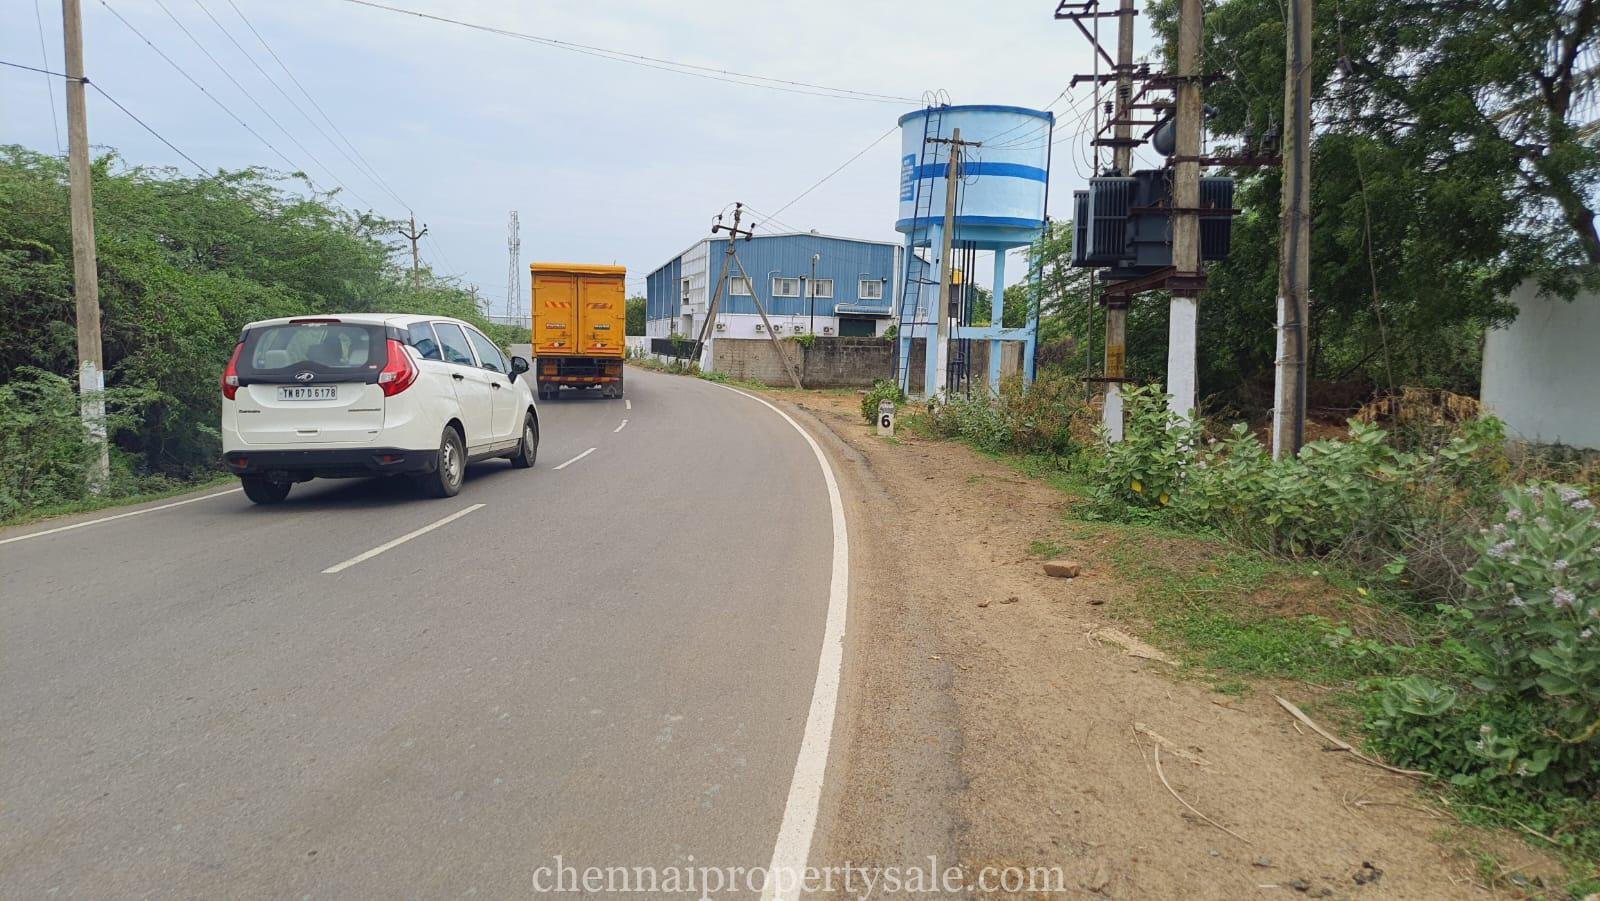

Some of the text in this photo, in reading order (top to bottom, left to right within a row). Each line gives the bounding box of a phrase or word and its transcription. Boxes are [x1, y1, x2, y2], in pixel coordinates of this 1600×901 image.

[284, 389, 336, 398] TN 87 D 6178
[881, 414, 891, 428] 6
